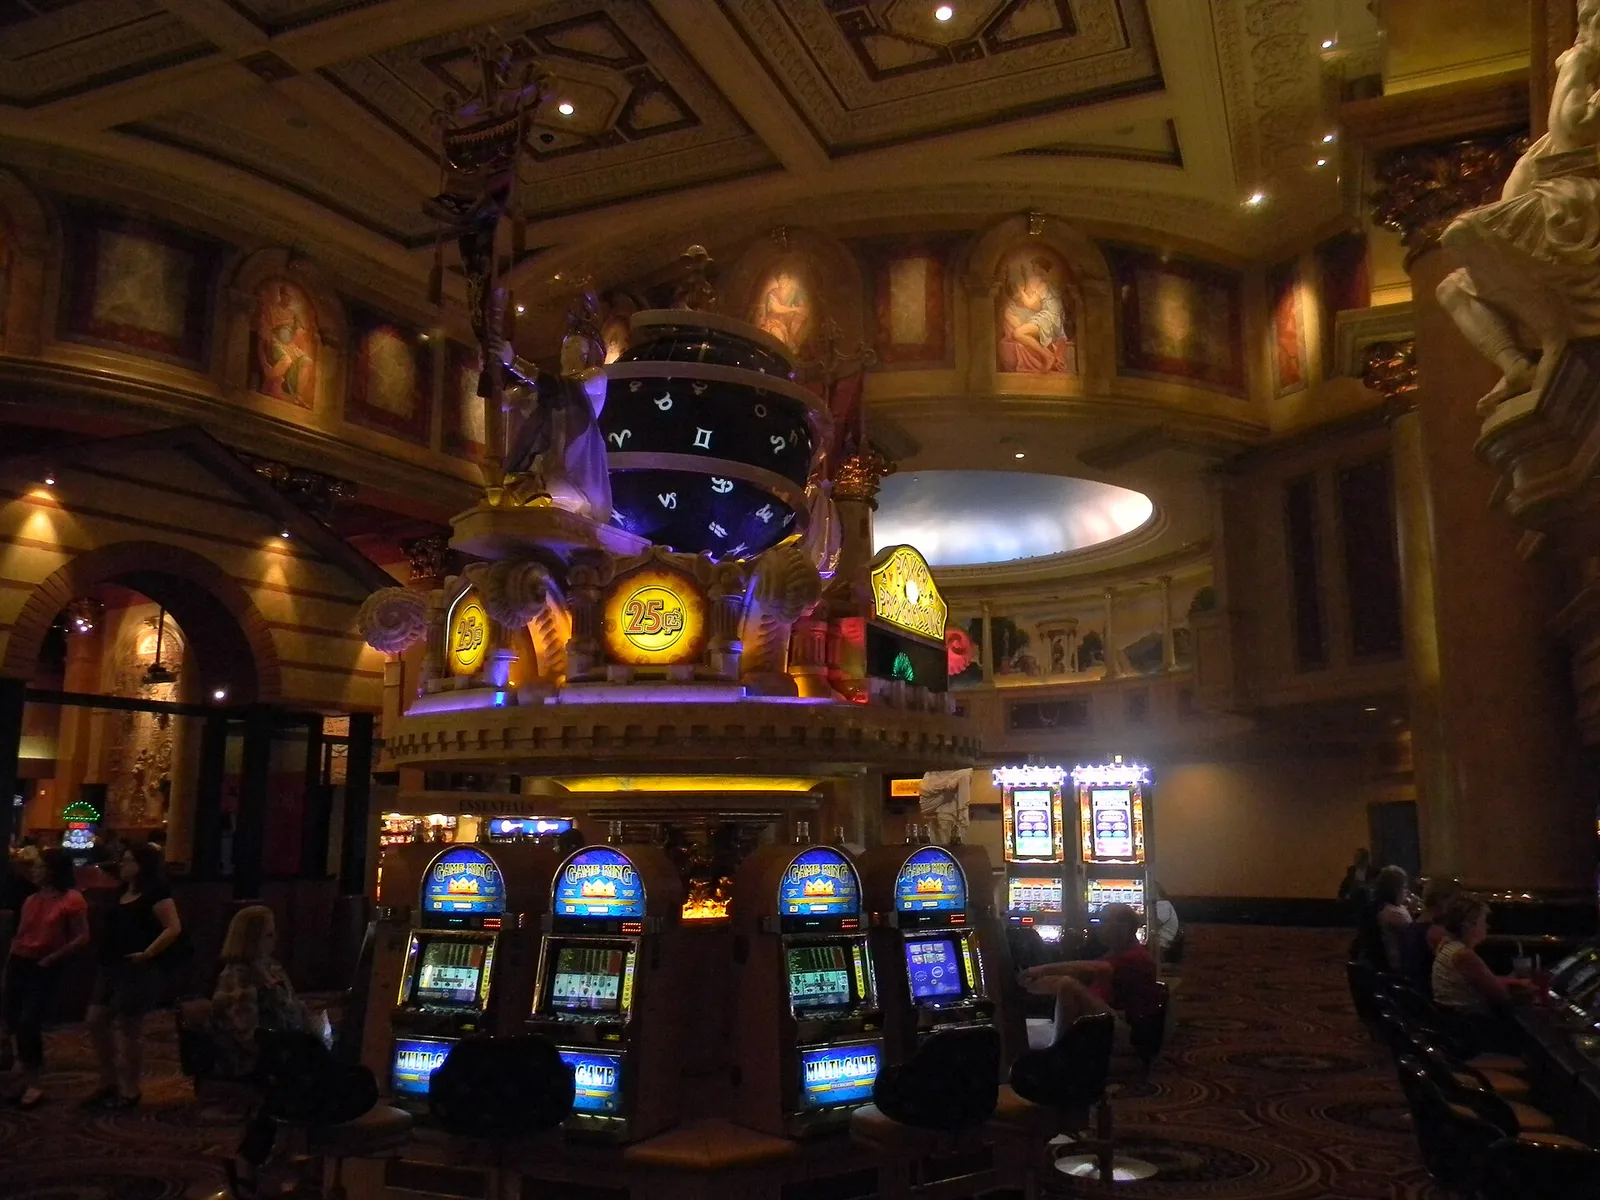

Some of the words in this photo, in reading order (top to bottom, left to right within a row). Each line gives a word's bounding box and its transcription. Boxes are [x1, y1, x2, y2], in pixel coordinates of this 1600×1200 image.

[459, 799, 534, 813] ESSENTIALS
[434, 862, 465, 882] GAME
[466, 862, 493, 882] KING
[565, 864, 600, 885] GAME
[602, 864, 633, 885] KING
[789, 864, 820, 884] GAME
[821, 864, 848, 884] KING
[904, 863, 931, 882] GAME
[397, 1051, 448, 1070] MULTI-G
[806, 1055, 876, 1082] MULTI-GAME
